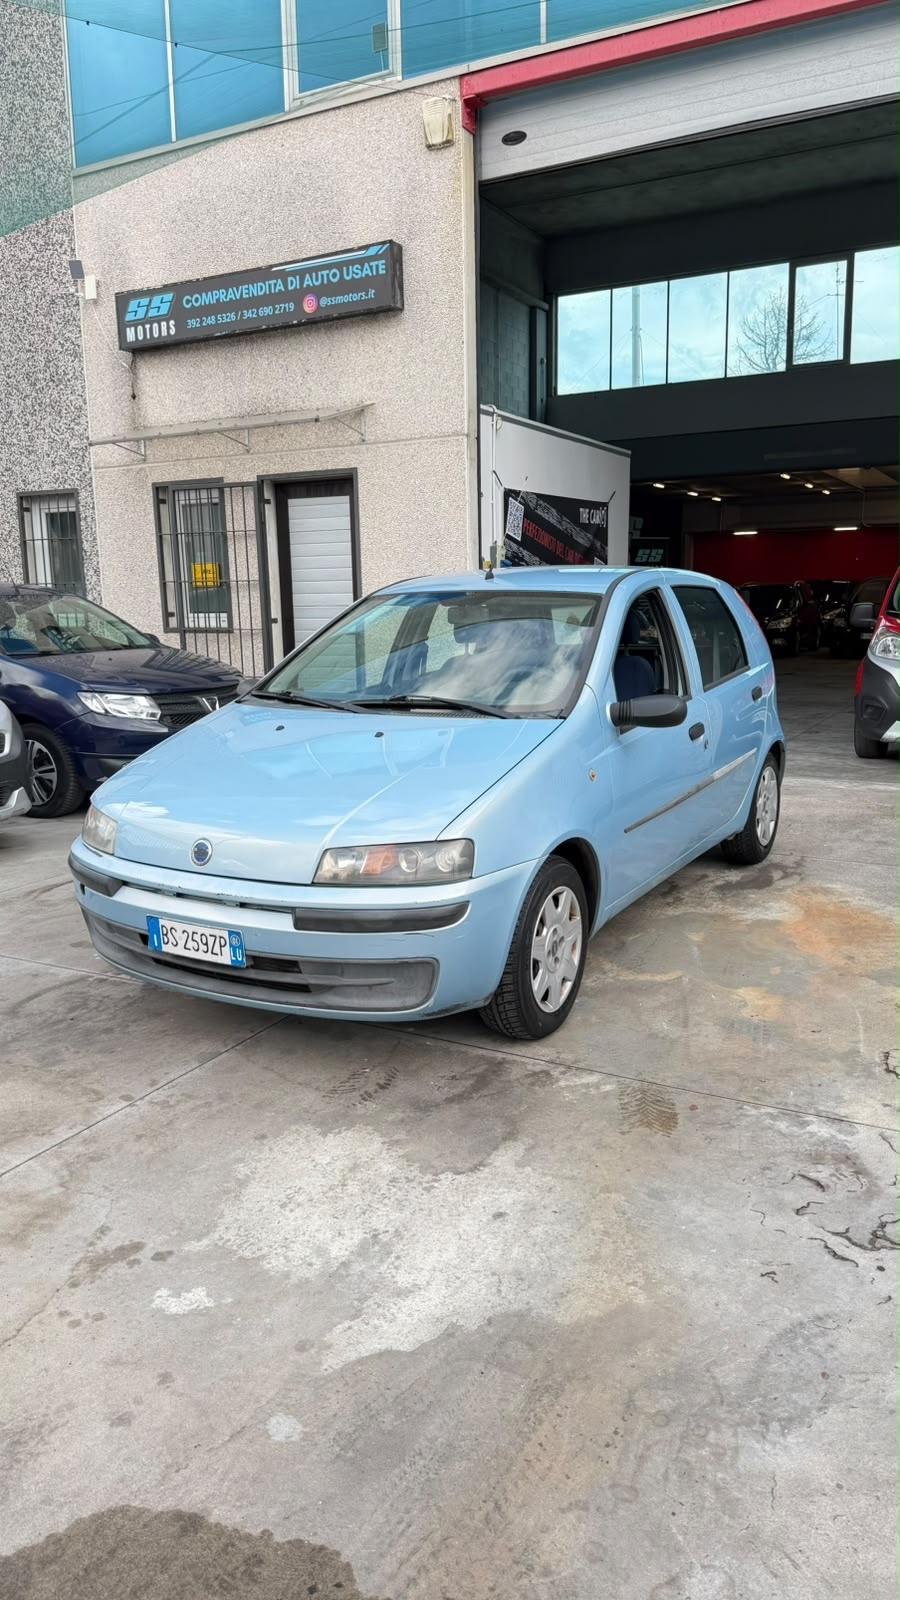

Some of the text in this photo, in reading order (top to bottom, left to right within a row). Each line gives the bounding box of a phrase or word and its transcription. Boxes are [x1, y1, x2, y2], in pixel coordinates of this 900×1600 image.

[183, 260, 386, 308] COMPRAVENDITA DI AUTO USATE
[125, 293, 174, 322] SS
[319, 288, 376, 307] @ssmotors.it
[186, 319, 200, 329] 392
[202, 317, 215, 328] 248
[217, 312, 236, 324] 5326
[243, 308, 257, 320] 342
[259, 306, 273, 317] 690
[275, 302, 294, 314] 2719
[126, 320, 176, 342] MOTORS
[579, 507, 589, 523] THE
[161, 924, 178, 948] BS
[182, 930, 227, 956] 259ZP
[230, 947, 242, 961] LU
